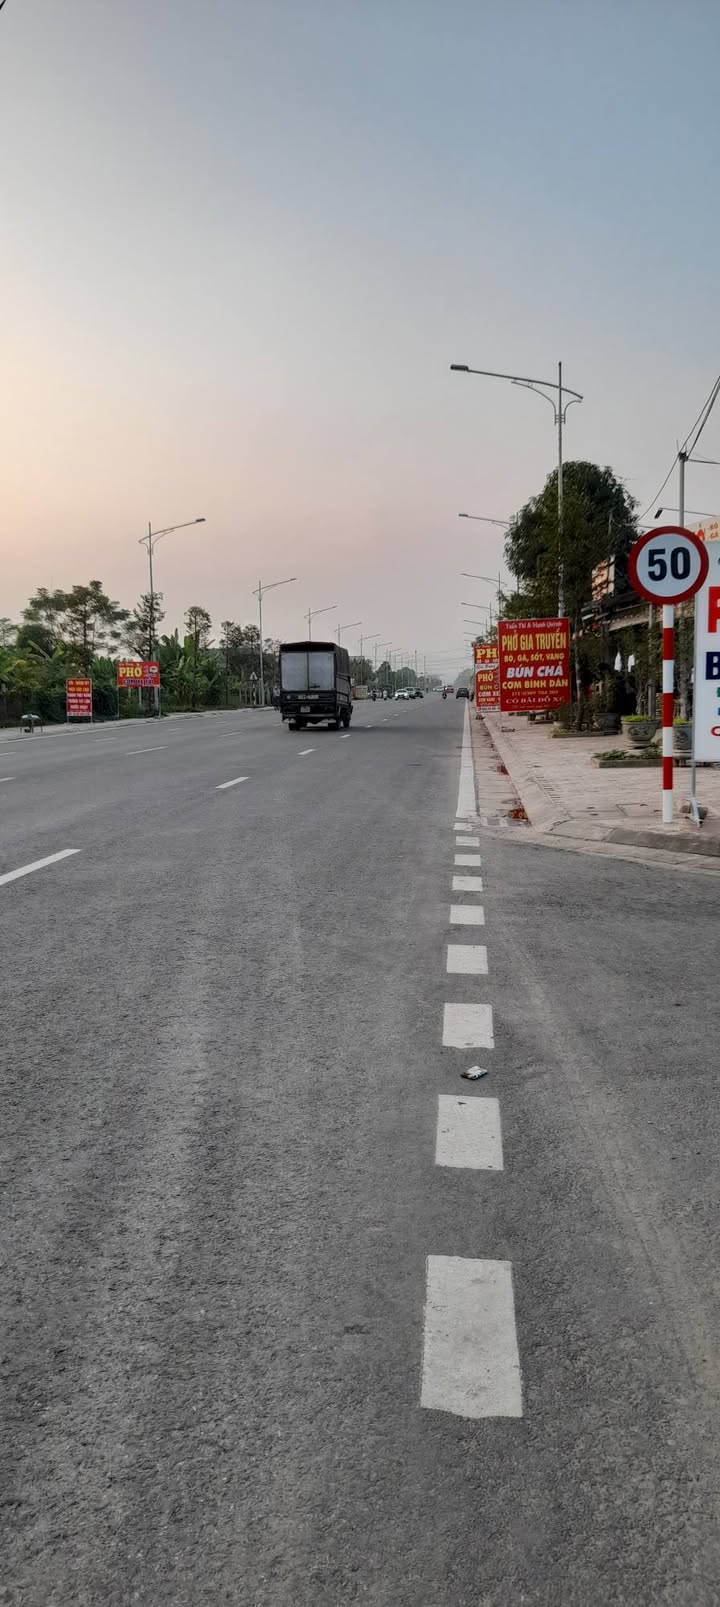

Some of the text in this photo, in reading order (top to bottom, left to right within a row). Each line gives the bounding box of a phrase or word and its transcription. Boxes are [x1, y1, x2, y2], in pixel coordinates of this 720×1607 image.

[648, 547, 691, 582] 50
[502, 630, 518, 651] PHỞ
[520, 634, 534, 650] GIA
[476, 648, 497, 658] PH
[119, 664, 142, 677] PHỞ
[477, 671, 493, 682] PHỞ
[507, 662, 563, 678] BÚN CHẢ
